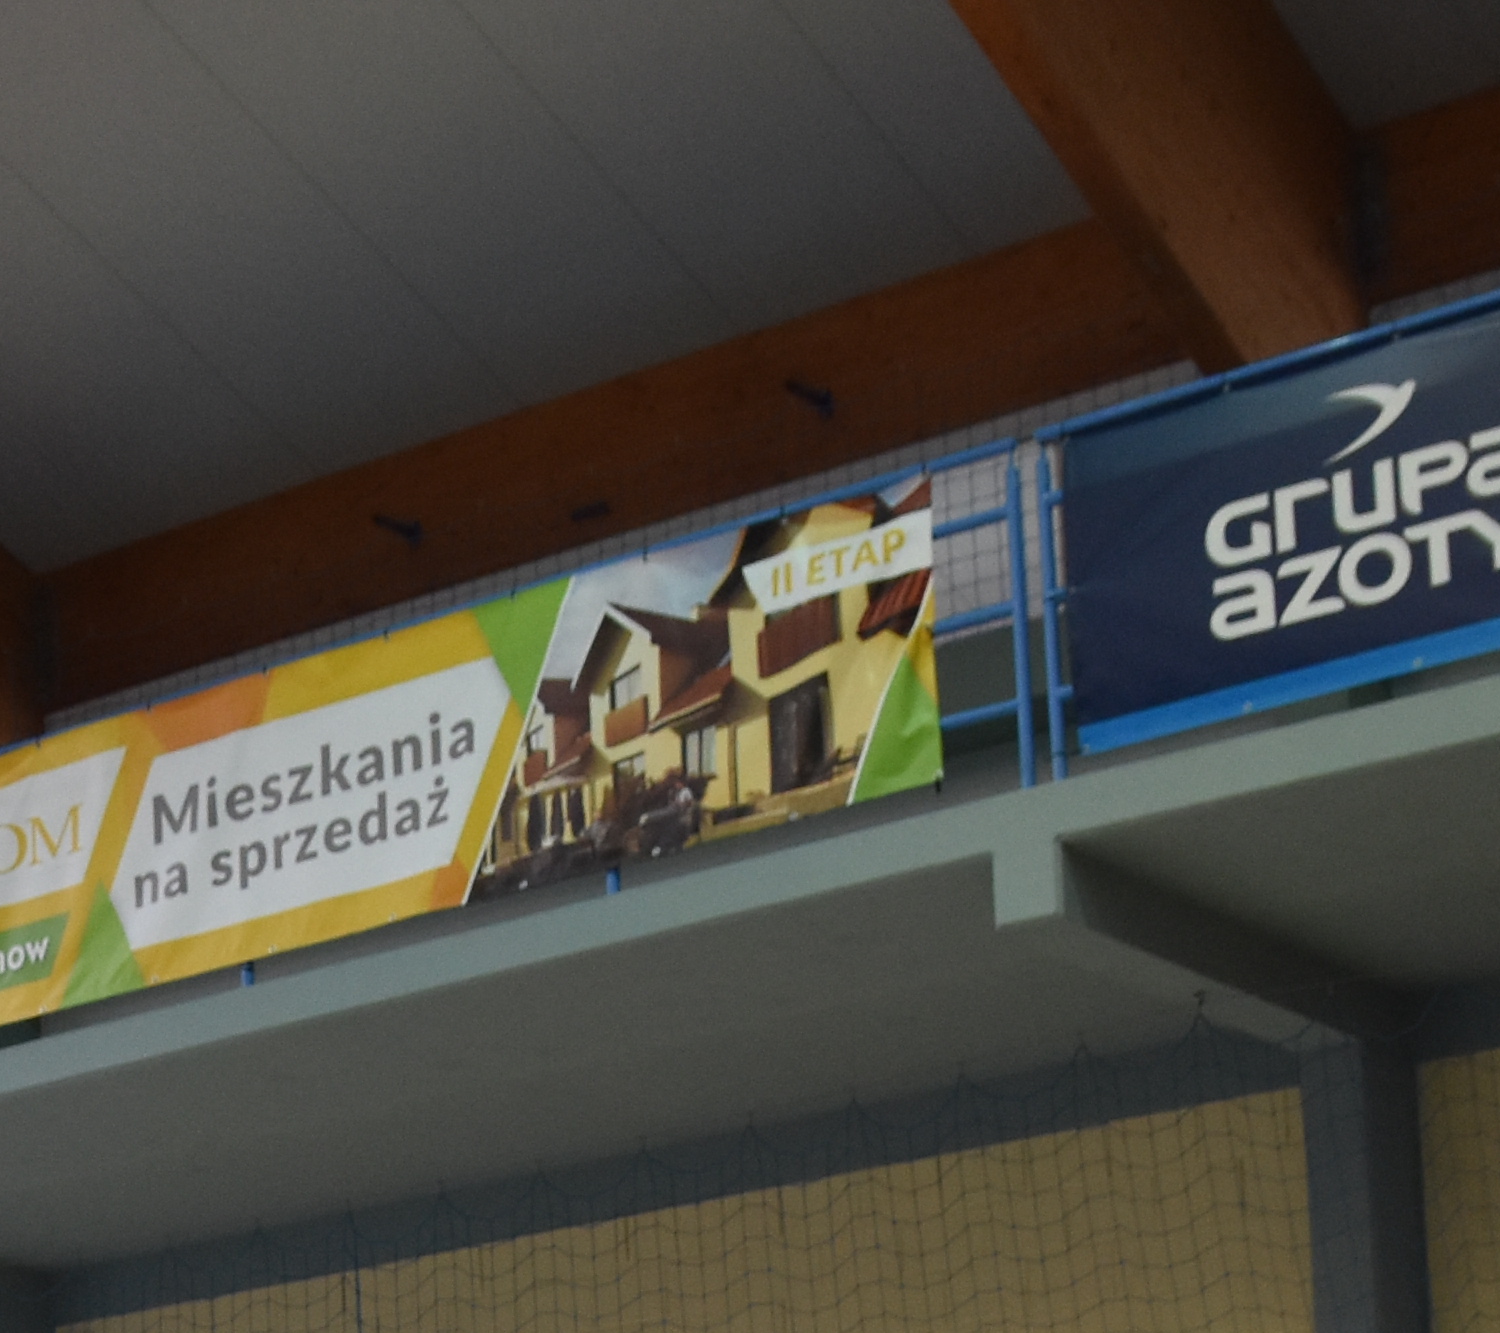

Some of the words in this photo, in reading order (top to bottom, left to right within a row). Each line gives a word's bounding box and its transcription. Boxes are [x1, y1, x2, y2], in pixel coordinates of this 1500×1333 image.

[769, 561, 796, 599] II
[806, 526, 908, 588] ETAP
[133, 857, 191, 908] na
[210, 774, 452, 891] sprzedaż
[151, 709, 478, 846] Mieszkania
